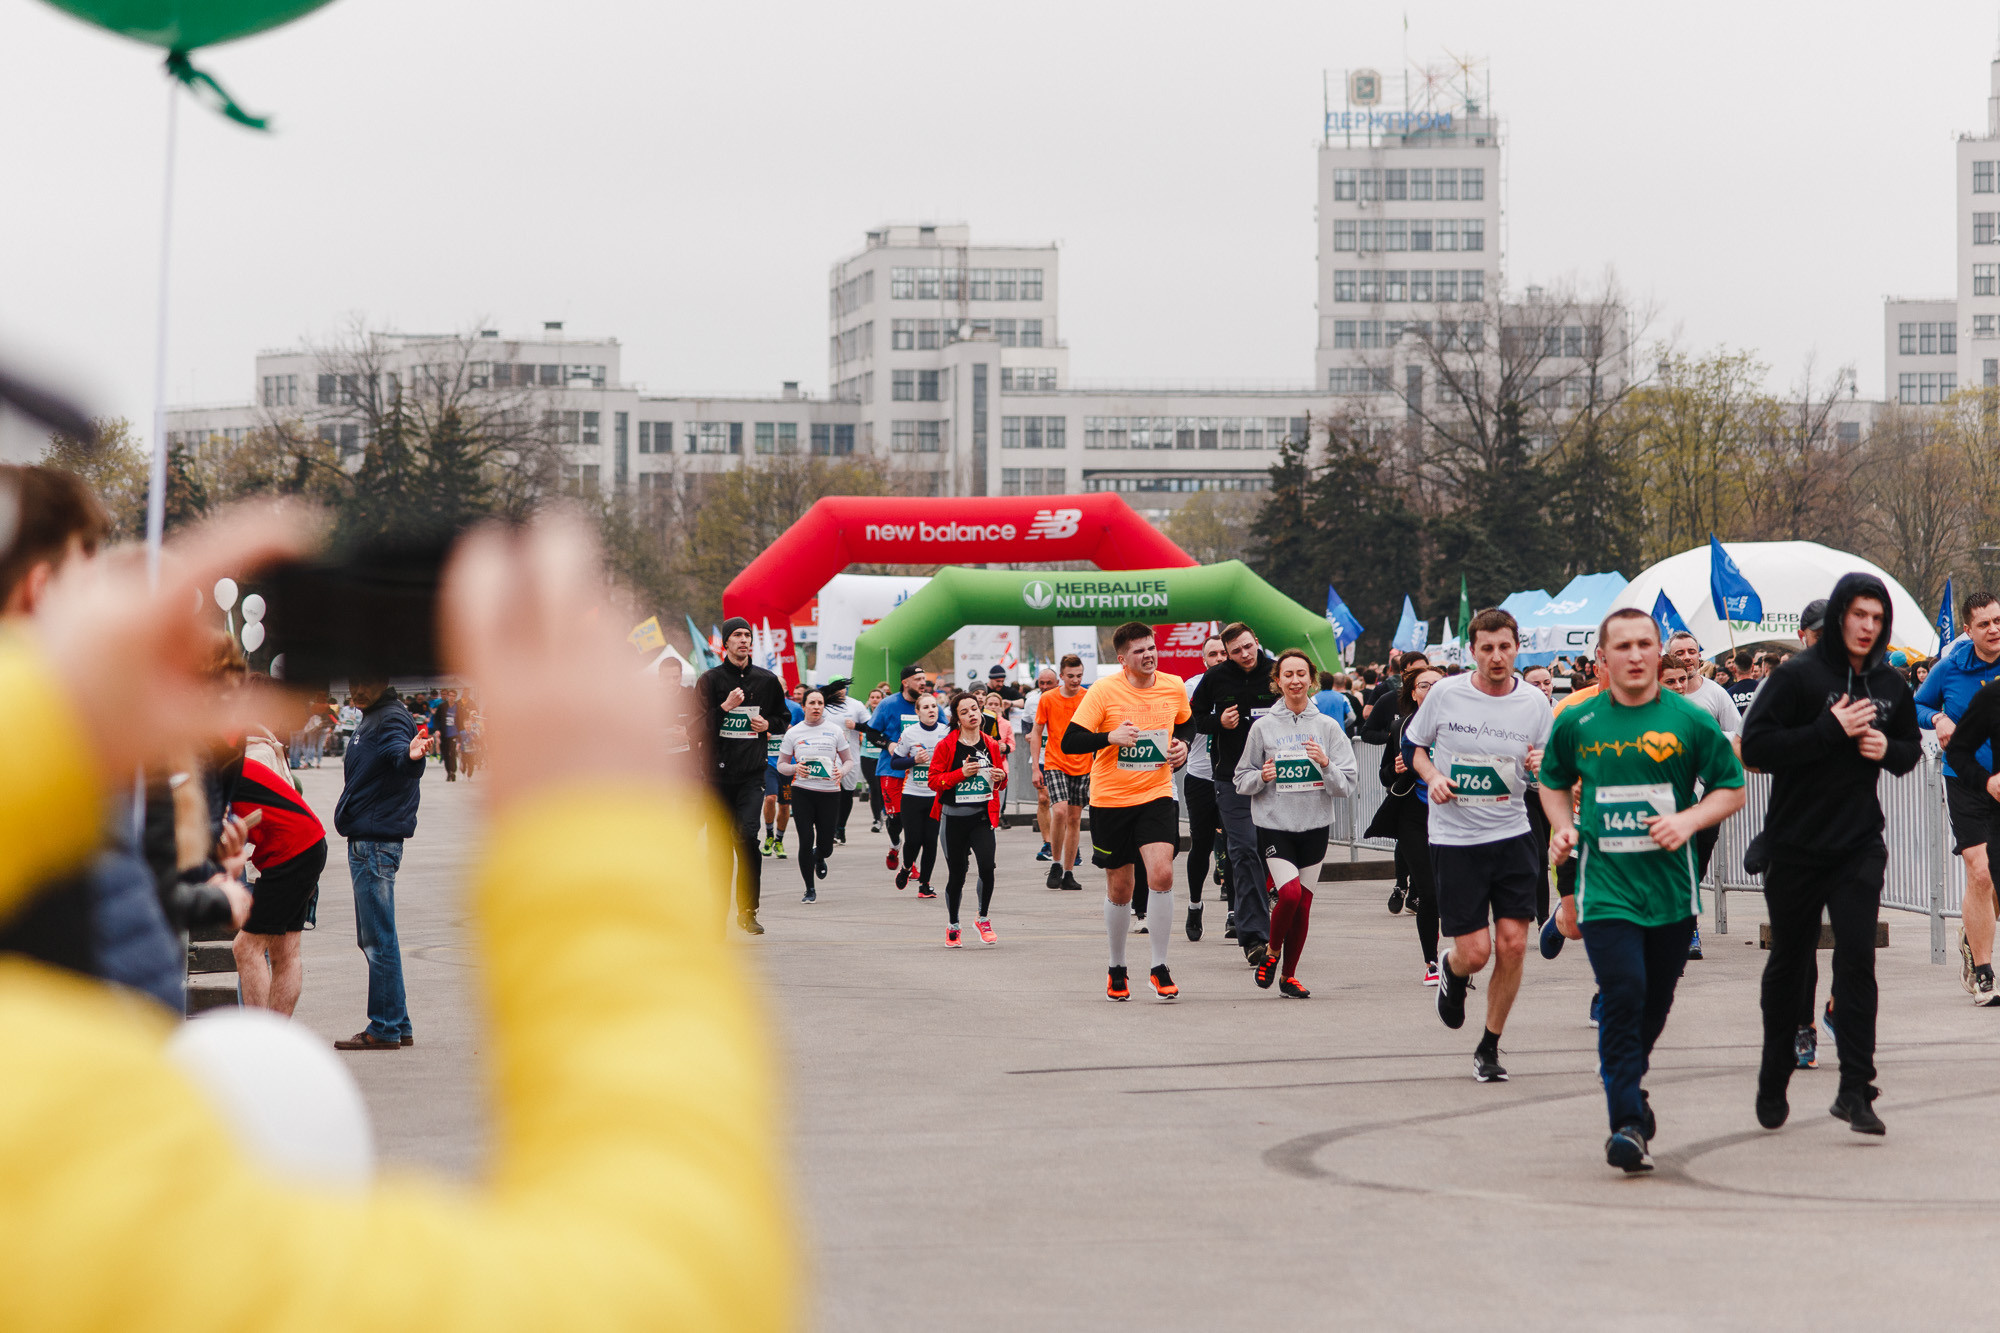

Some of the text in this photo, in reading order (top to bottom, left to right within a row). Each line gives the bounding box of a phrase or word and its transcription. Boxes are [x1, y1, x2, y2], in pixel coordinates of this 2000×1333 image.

[1325, 111, 1452, 131] ДЕРЖПРОМ
[866, 524, 915, 541] new
[919, 521, 1017, 542] balance
[1056, 581, 1167, 594] HERBALIFE
[1056, 593, 1168, 608] NUTRITION
[1056, 610, 1098, 618] FAMILY
[1101, 610, 1125, 618] RUN
[1148, 608, 1168, 617] KM
[723, 718, 748, 728] 2707
[1120, 746, 1154, 758] 3097
[1278, 766, 1311, 778] 2637
[957, 781, 985, 792] 2245
[1455, 773, 1492, 790] 1766
[1603, 810, 1649, 831] 1445
